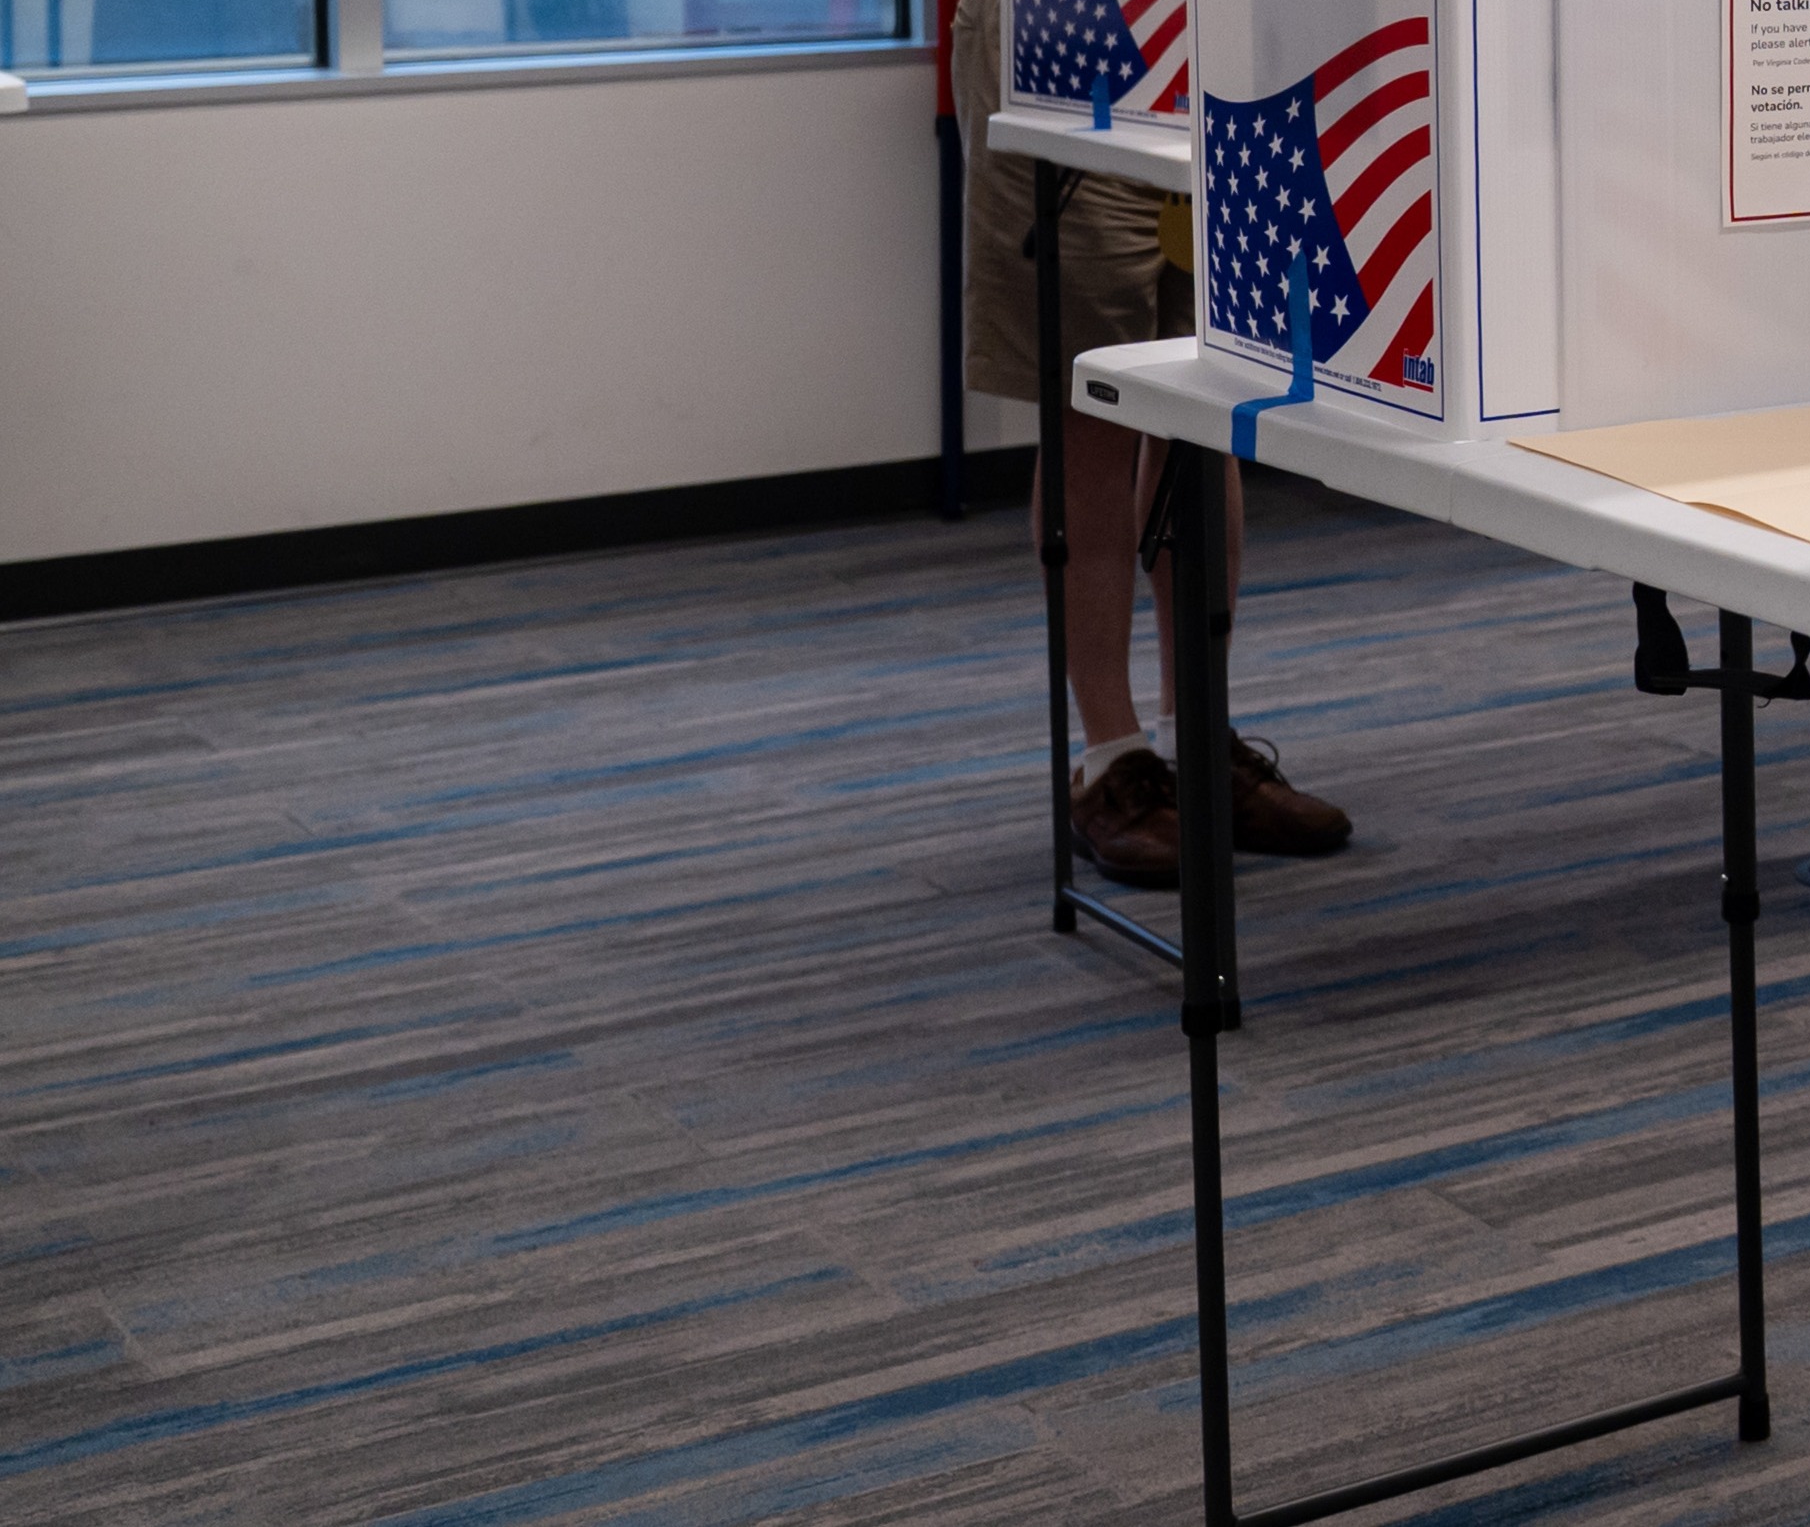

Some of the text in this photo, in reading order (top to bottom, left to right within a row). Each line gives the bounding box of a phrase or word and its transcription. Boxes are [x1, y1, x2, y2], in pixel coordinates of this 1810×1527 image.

[1751, 23, 1758, 34] If
[1761, 26, 1780, 35] you
[1783, 23, 1807, 34] have
[1751, 39, 1785, 51] please
[1751, 85, 1767, 96] No
[1771, 86, 1784, 95] se
[1751, 100, 1803, 113] votación.
[1750, 122, 1759, 131] Si
[1761, 122, 1782, 131] tiene
[1750, 133, 1795, 145] trabajador
[1404, 351, 1435, 385] intab
